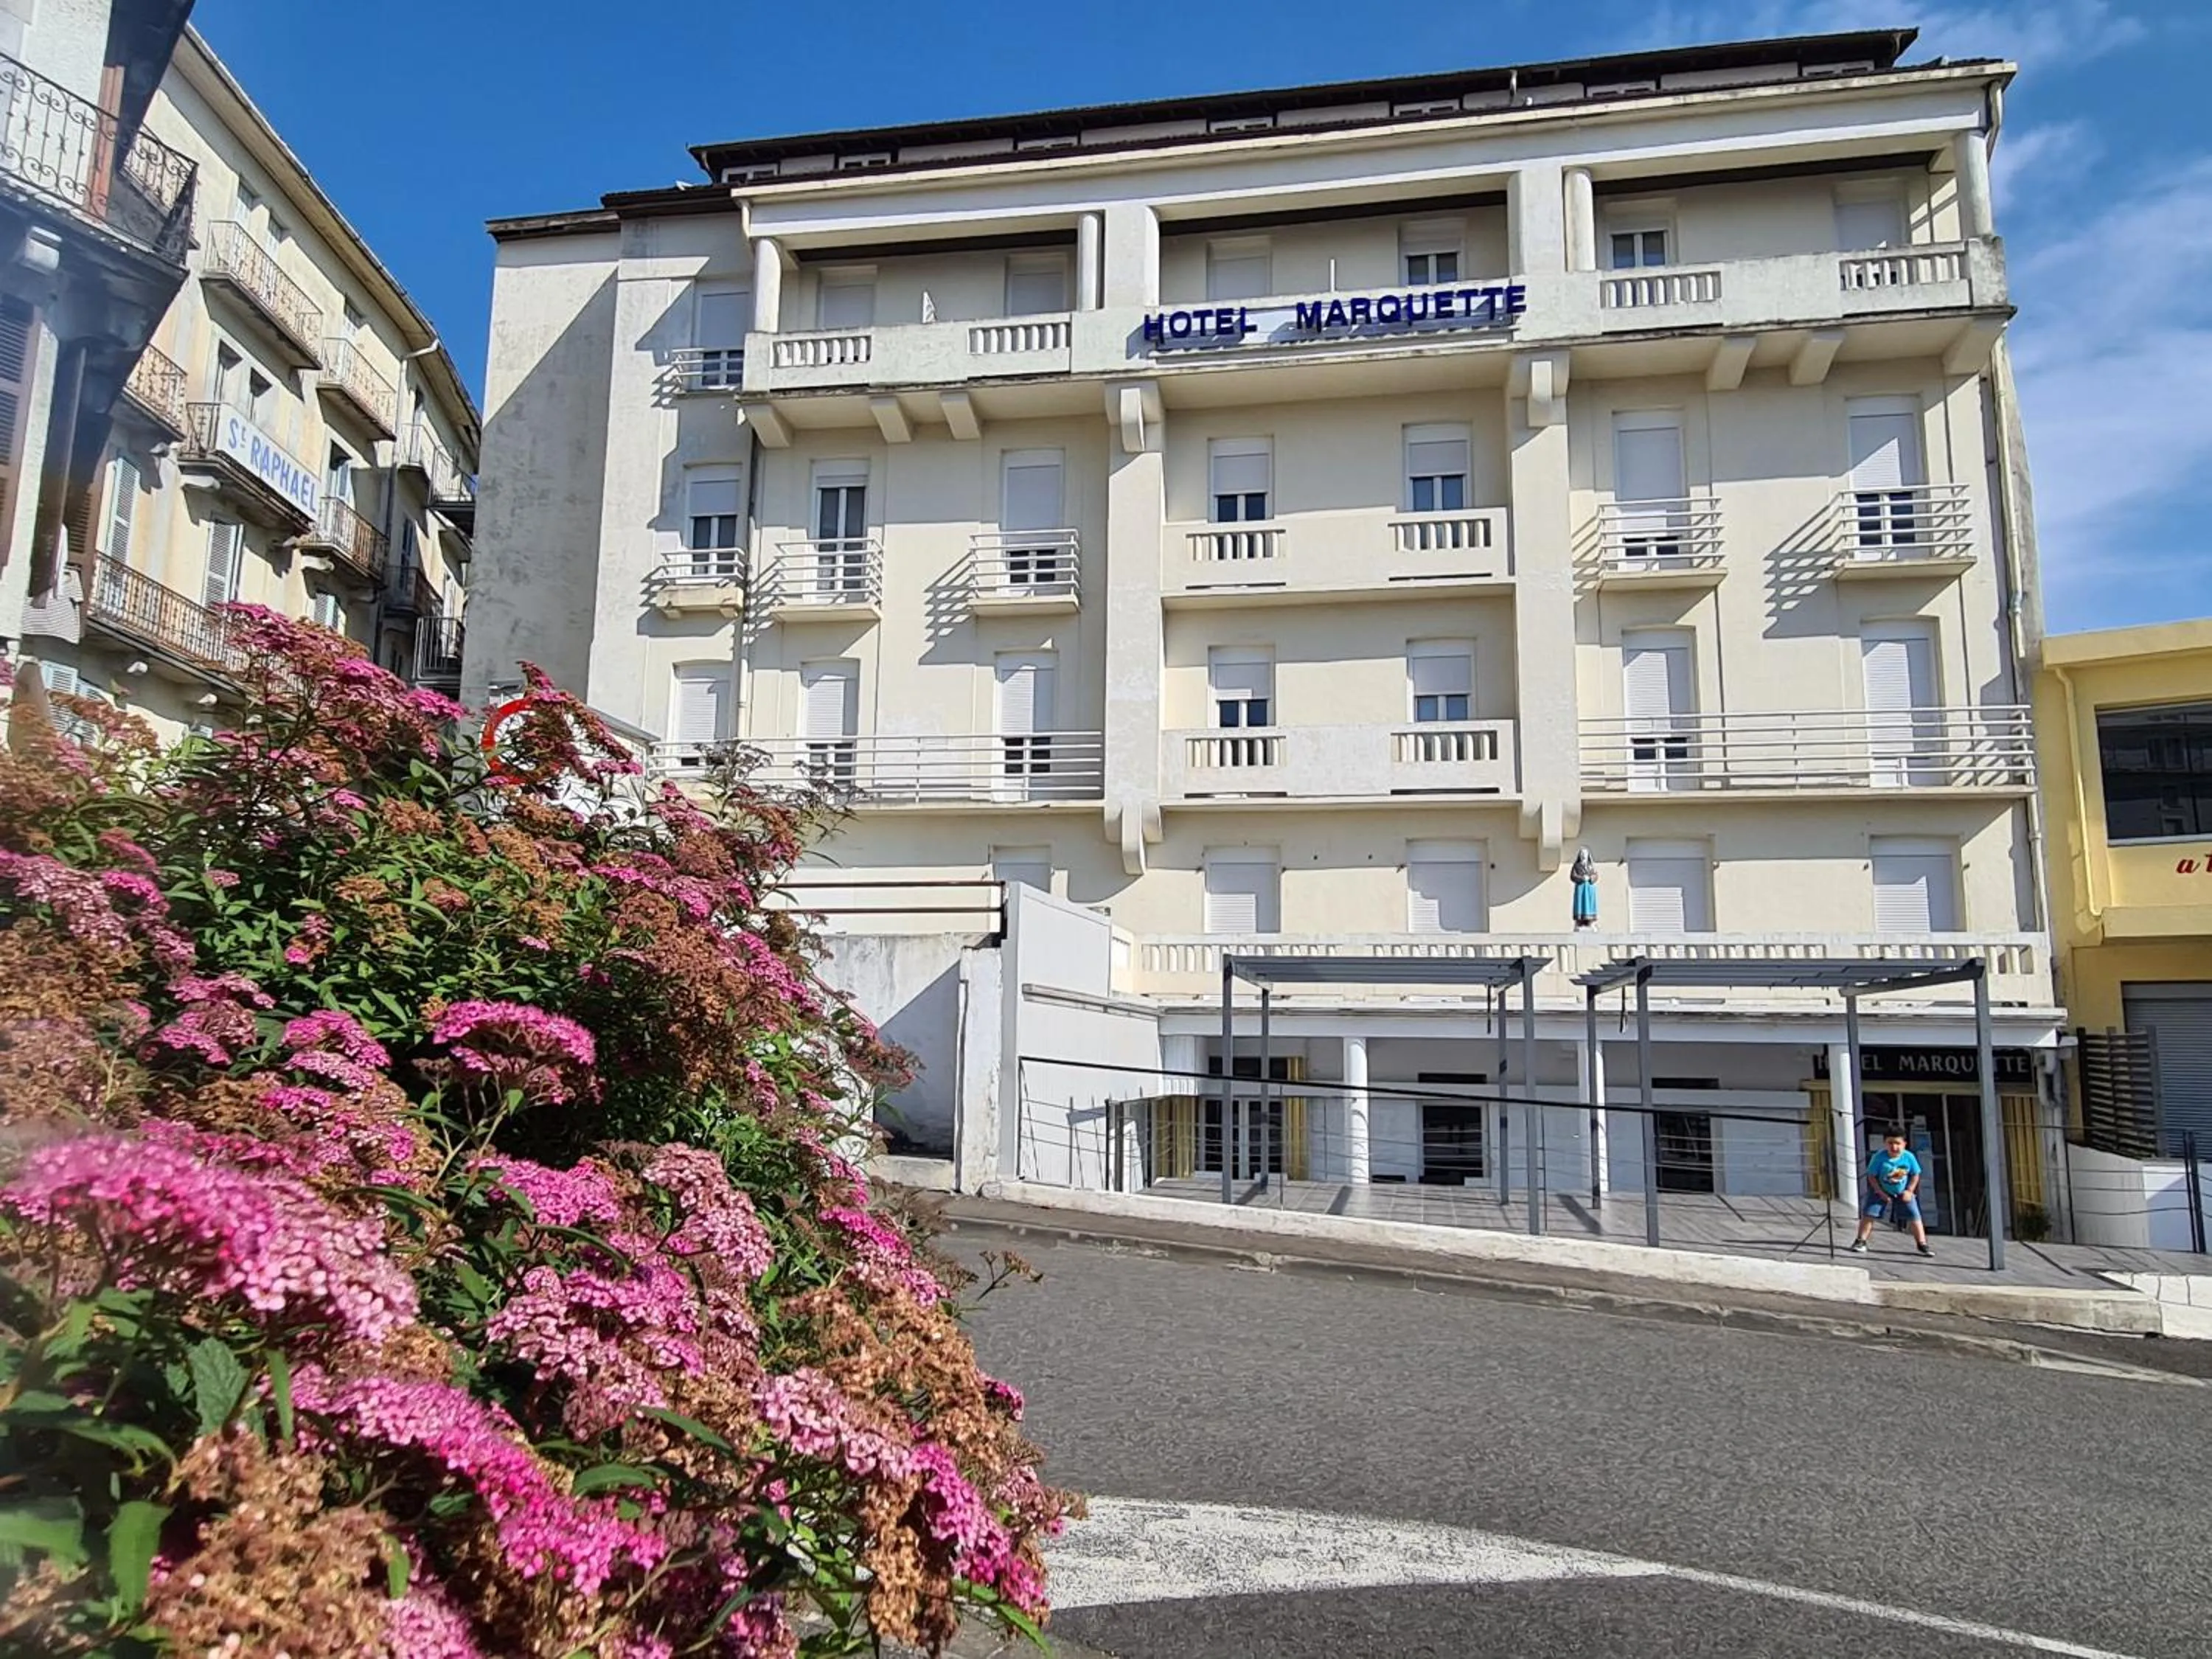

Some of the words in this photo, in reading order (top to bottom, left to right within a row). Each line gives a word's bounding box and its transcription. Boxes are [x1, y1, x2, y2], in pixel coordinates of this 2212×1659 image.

[1144, 306, 1257, 344] HOTEL
[1296, 285, 1527, 333] MARQUETTE
[1818, 1054, 1883, 1071] HEL
[1898, 1054, 2031, 1074] MARQUTTE
